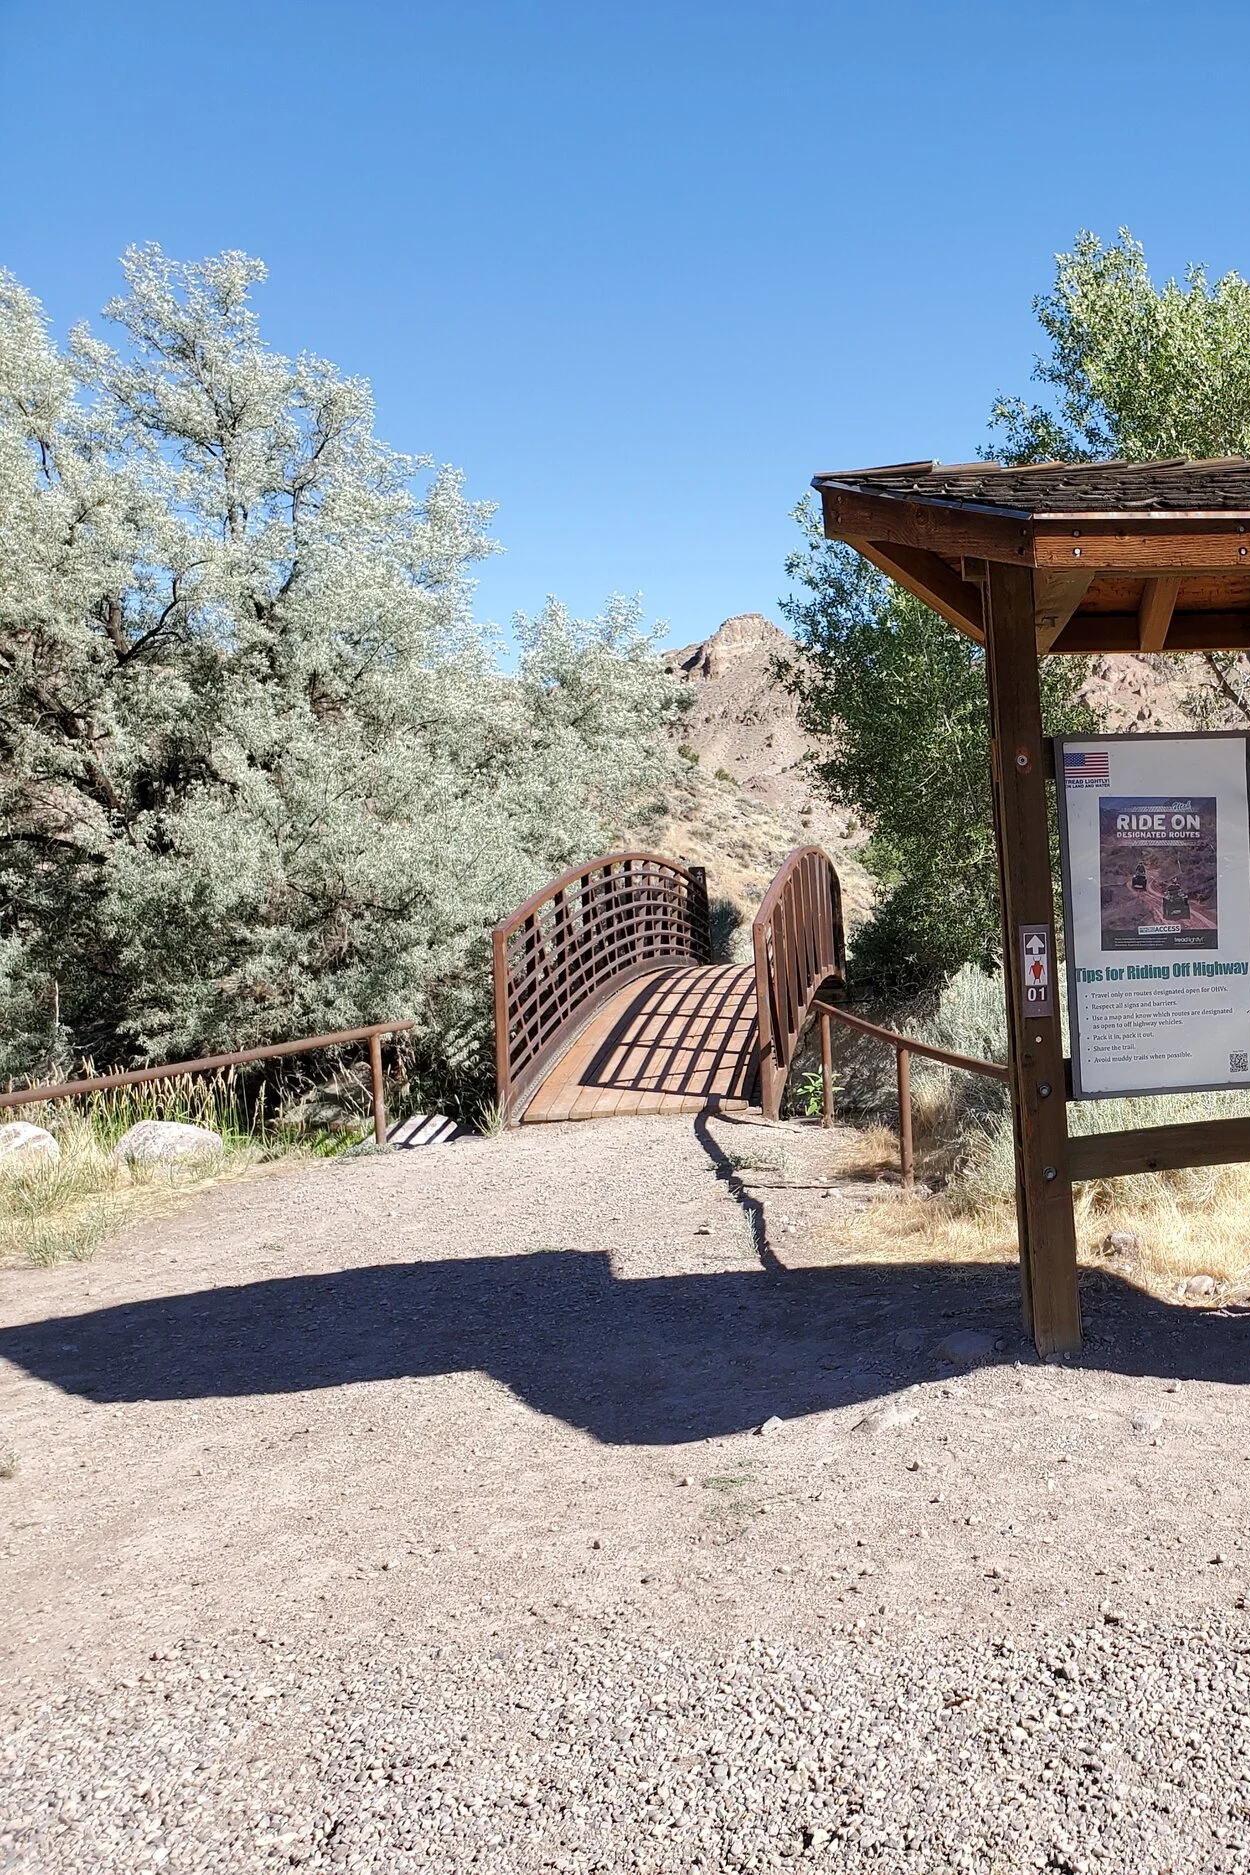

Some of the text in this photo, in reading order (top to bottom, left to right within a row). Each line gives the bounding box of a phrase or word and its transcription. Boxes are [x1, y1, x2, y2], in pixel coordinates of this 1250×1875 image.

[1117, 814, 1199, 830] RIDE ON
[1076, 961, 1248, 983] Tips for Riding Off Highway
[1028, 987, 1045, 1001] 01
[1201, 1008, 1233, 1016] designated
[1133, 1020, 1157, 1028] highway
[1122, 1032, 1136, 1040] pack
[1166, 1052, 1192, 1060] possible.
